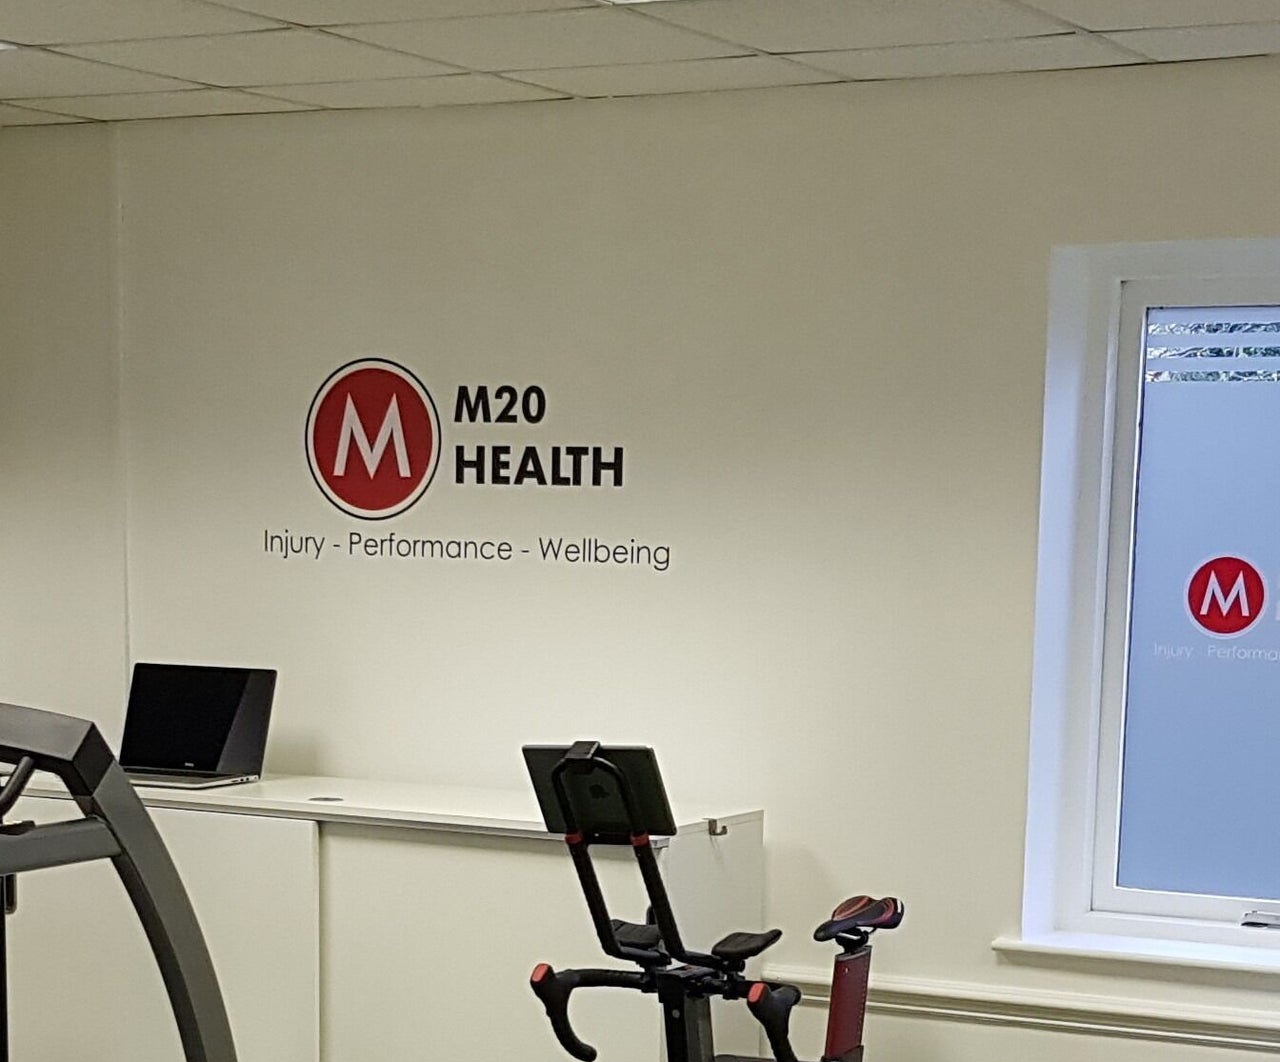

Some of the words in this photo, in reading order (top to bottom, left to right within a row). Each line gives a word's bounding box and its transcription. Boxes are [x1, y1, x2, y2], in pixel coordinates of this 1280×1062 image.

[454, 385, 546, 424] M20
[333, 392, 411, 480] M
[455, 445, 624, 487] HEALTH
[264, 530, 325, 559] Injury
[349, 532, 512, 560] Performance
[539, 537, 671, 571] Wellbeing
